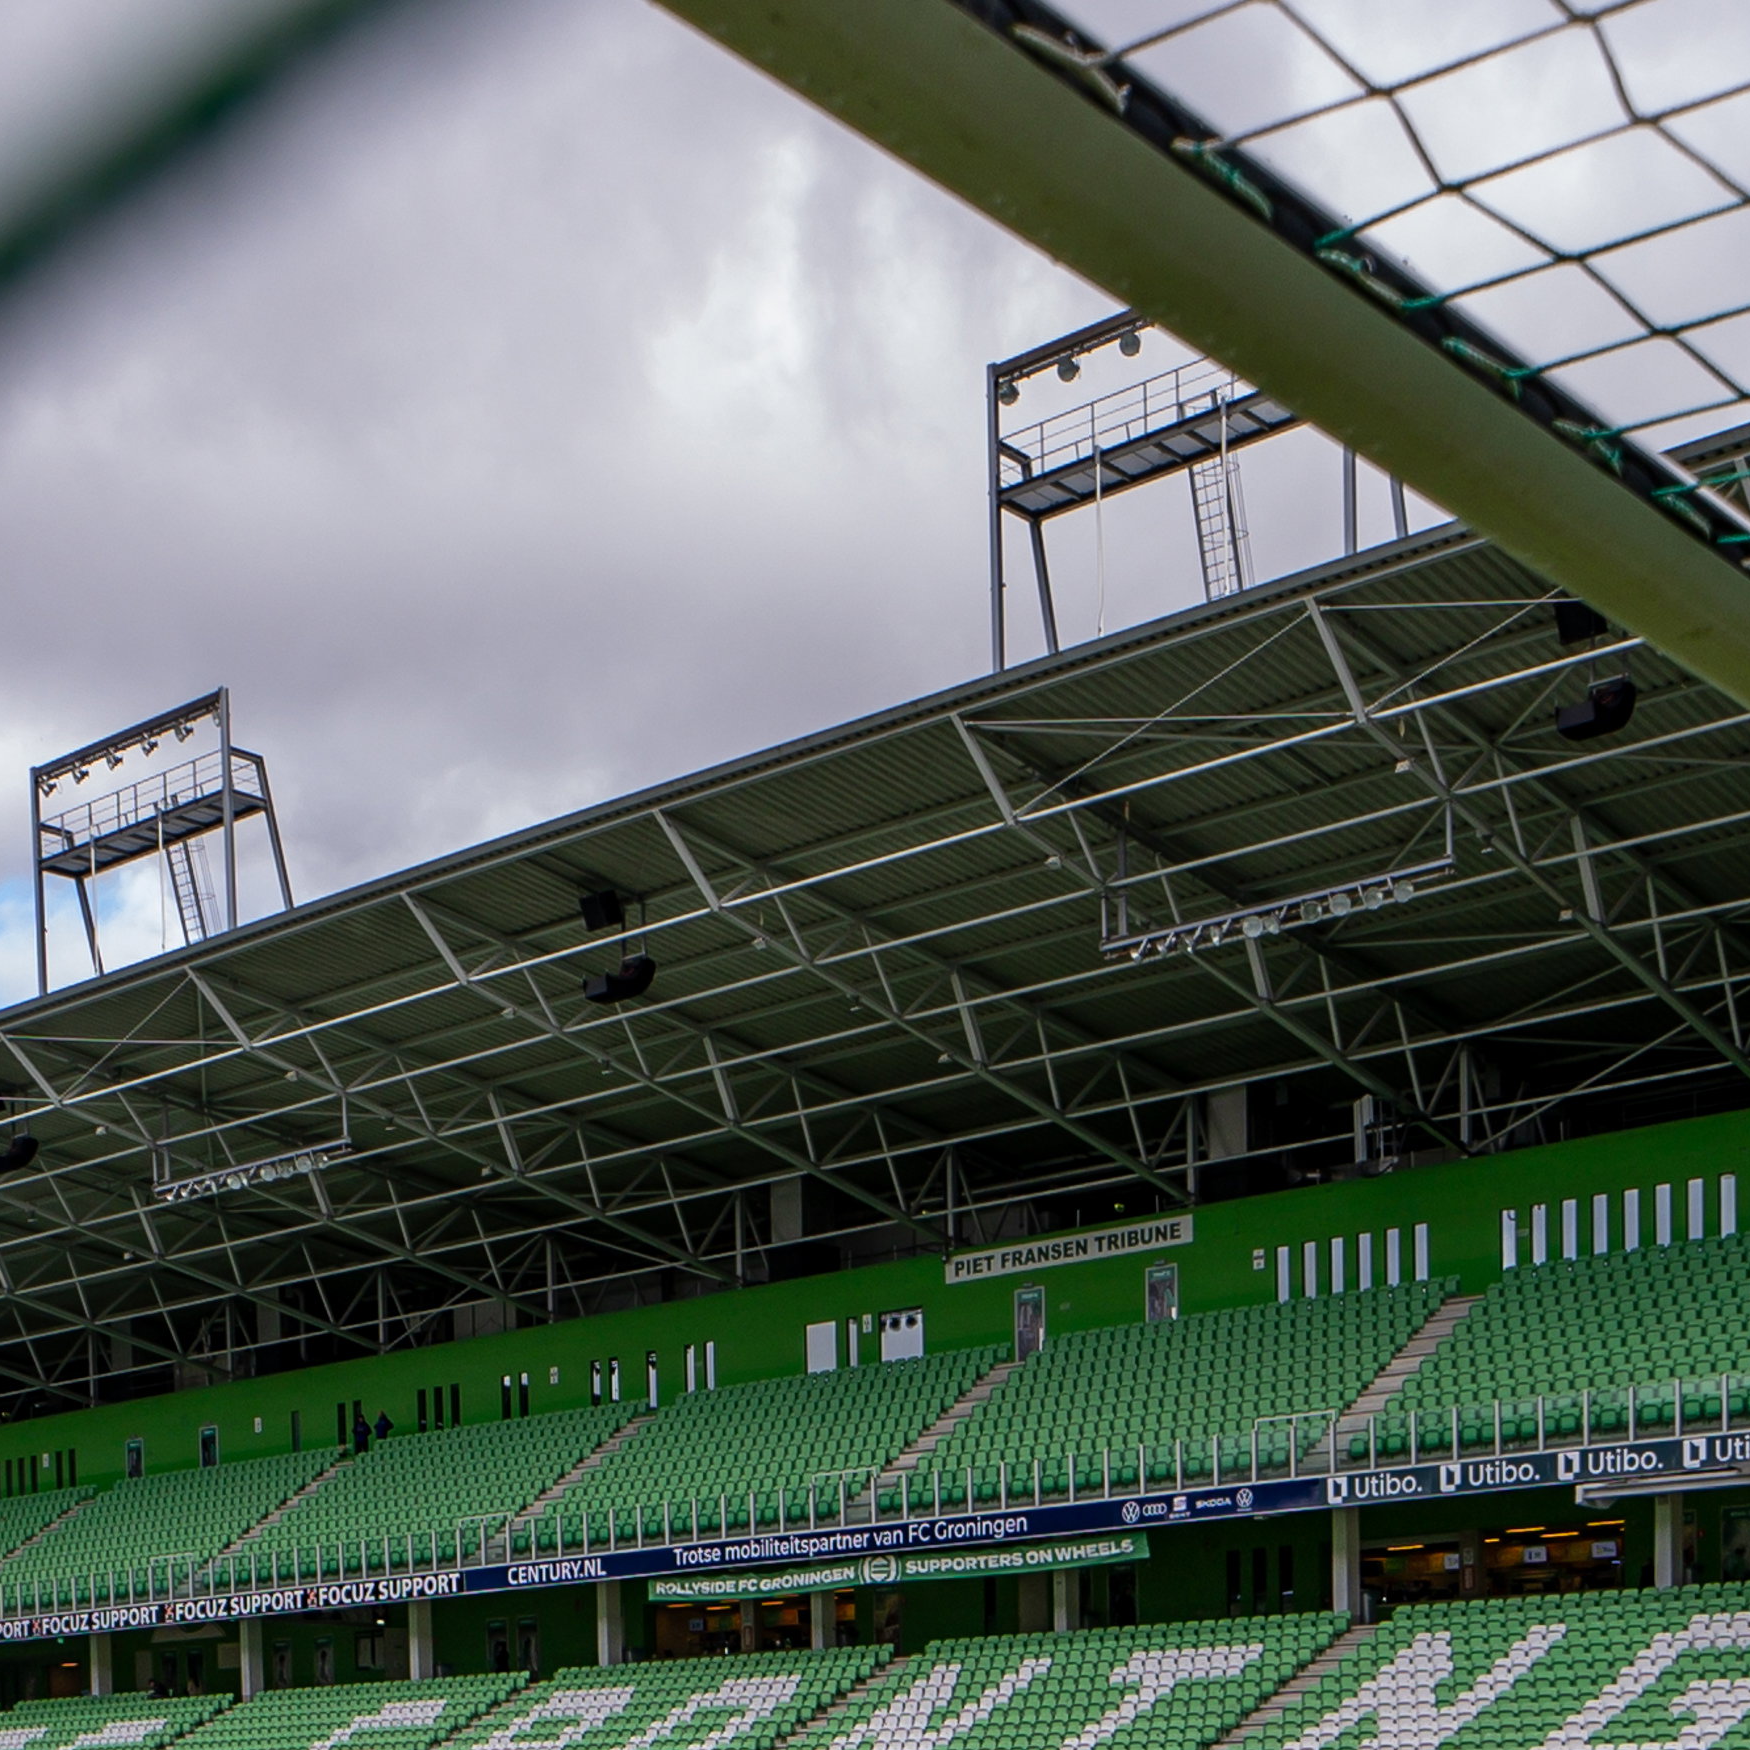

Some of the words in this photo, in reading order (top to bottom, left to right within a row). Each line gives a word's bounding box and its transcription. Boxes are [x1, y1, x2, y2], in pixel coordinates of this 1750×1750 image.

[953, 1254, 995, 1277] PIET
[1000, 1238, 1089, 1269] FRANSEN
[1094, 1221, 1182, 1250] TRIBUNE
[1468, 1460, 1540, 1485] Utibo.
[1587, 1448, 1664, 1475] Utibo.
[1354, 1474, 1423, 1498] Utibo.
[673, 1546, 721, 1566] Trotse
[725, 1529, 870, 1560] mobiliteitspartner
[874, 1530, 902, 1546] van
[908, 1523, 931, 1543] FC
[934, 1514, 1028, 1540] Groningen
[905, 1553, 1024, 1575] SUPPORTERS
[1026, 1551, 1053, 1564] ON
[1056, 1539, 1134, 1560] WHEELS
[507, 1558, 607, 1585] CENTURY.NL
[656, 1580, 736, 1595] ROLLYSIDE
[738, 1579, 758, 1592] FC
[760, 1567, 855, 1591] GRONINGEN
[318, 1582, 376, 1606] FOCUZ
[378, 1573, 461, 1601] SUPPORT
[175, 1598, 227, 1621] FOCUZ
[230, 1590, 304, 1615] SUPPORT
[42, 1612, 89, 1634] FOCUZ
[91, 1606, 159, 1630] SUPPORT
